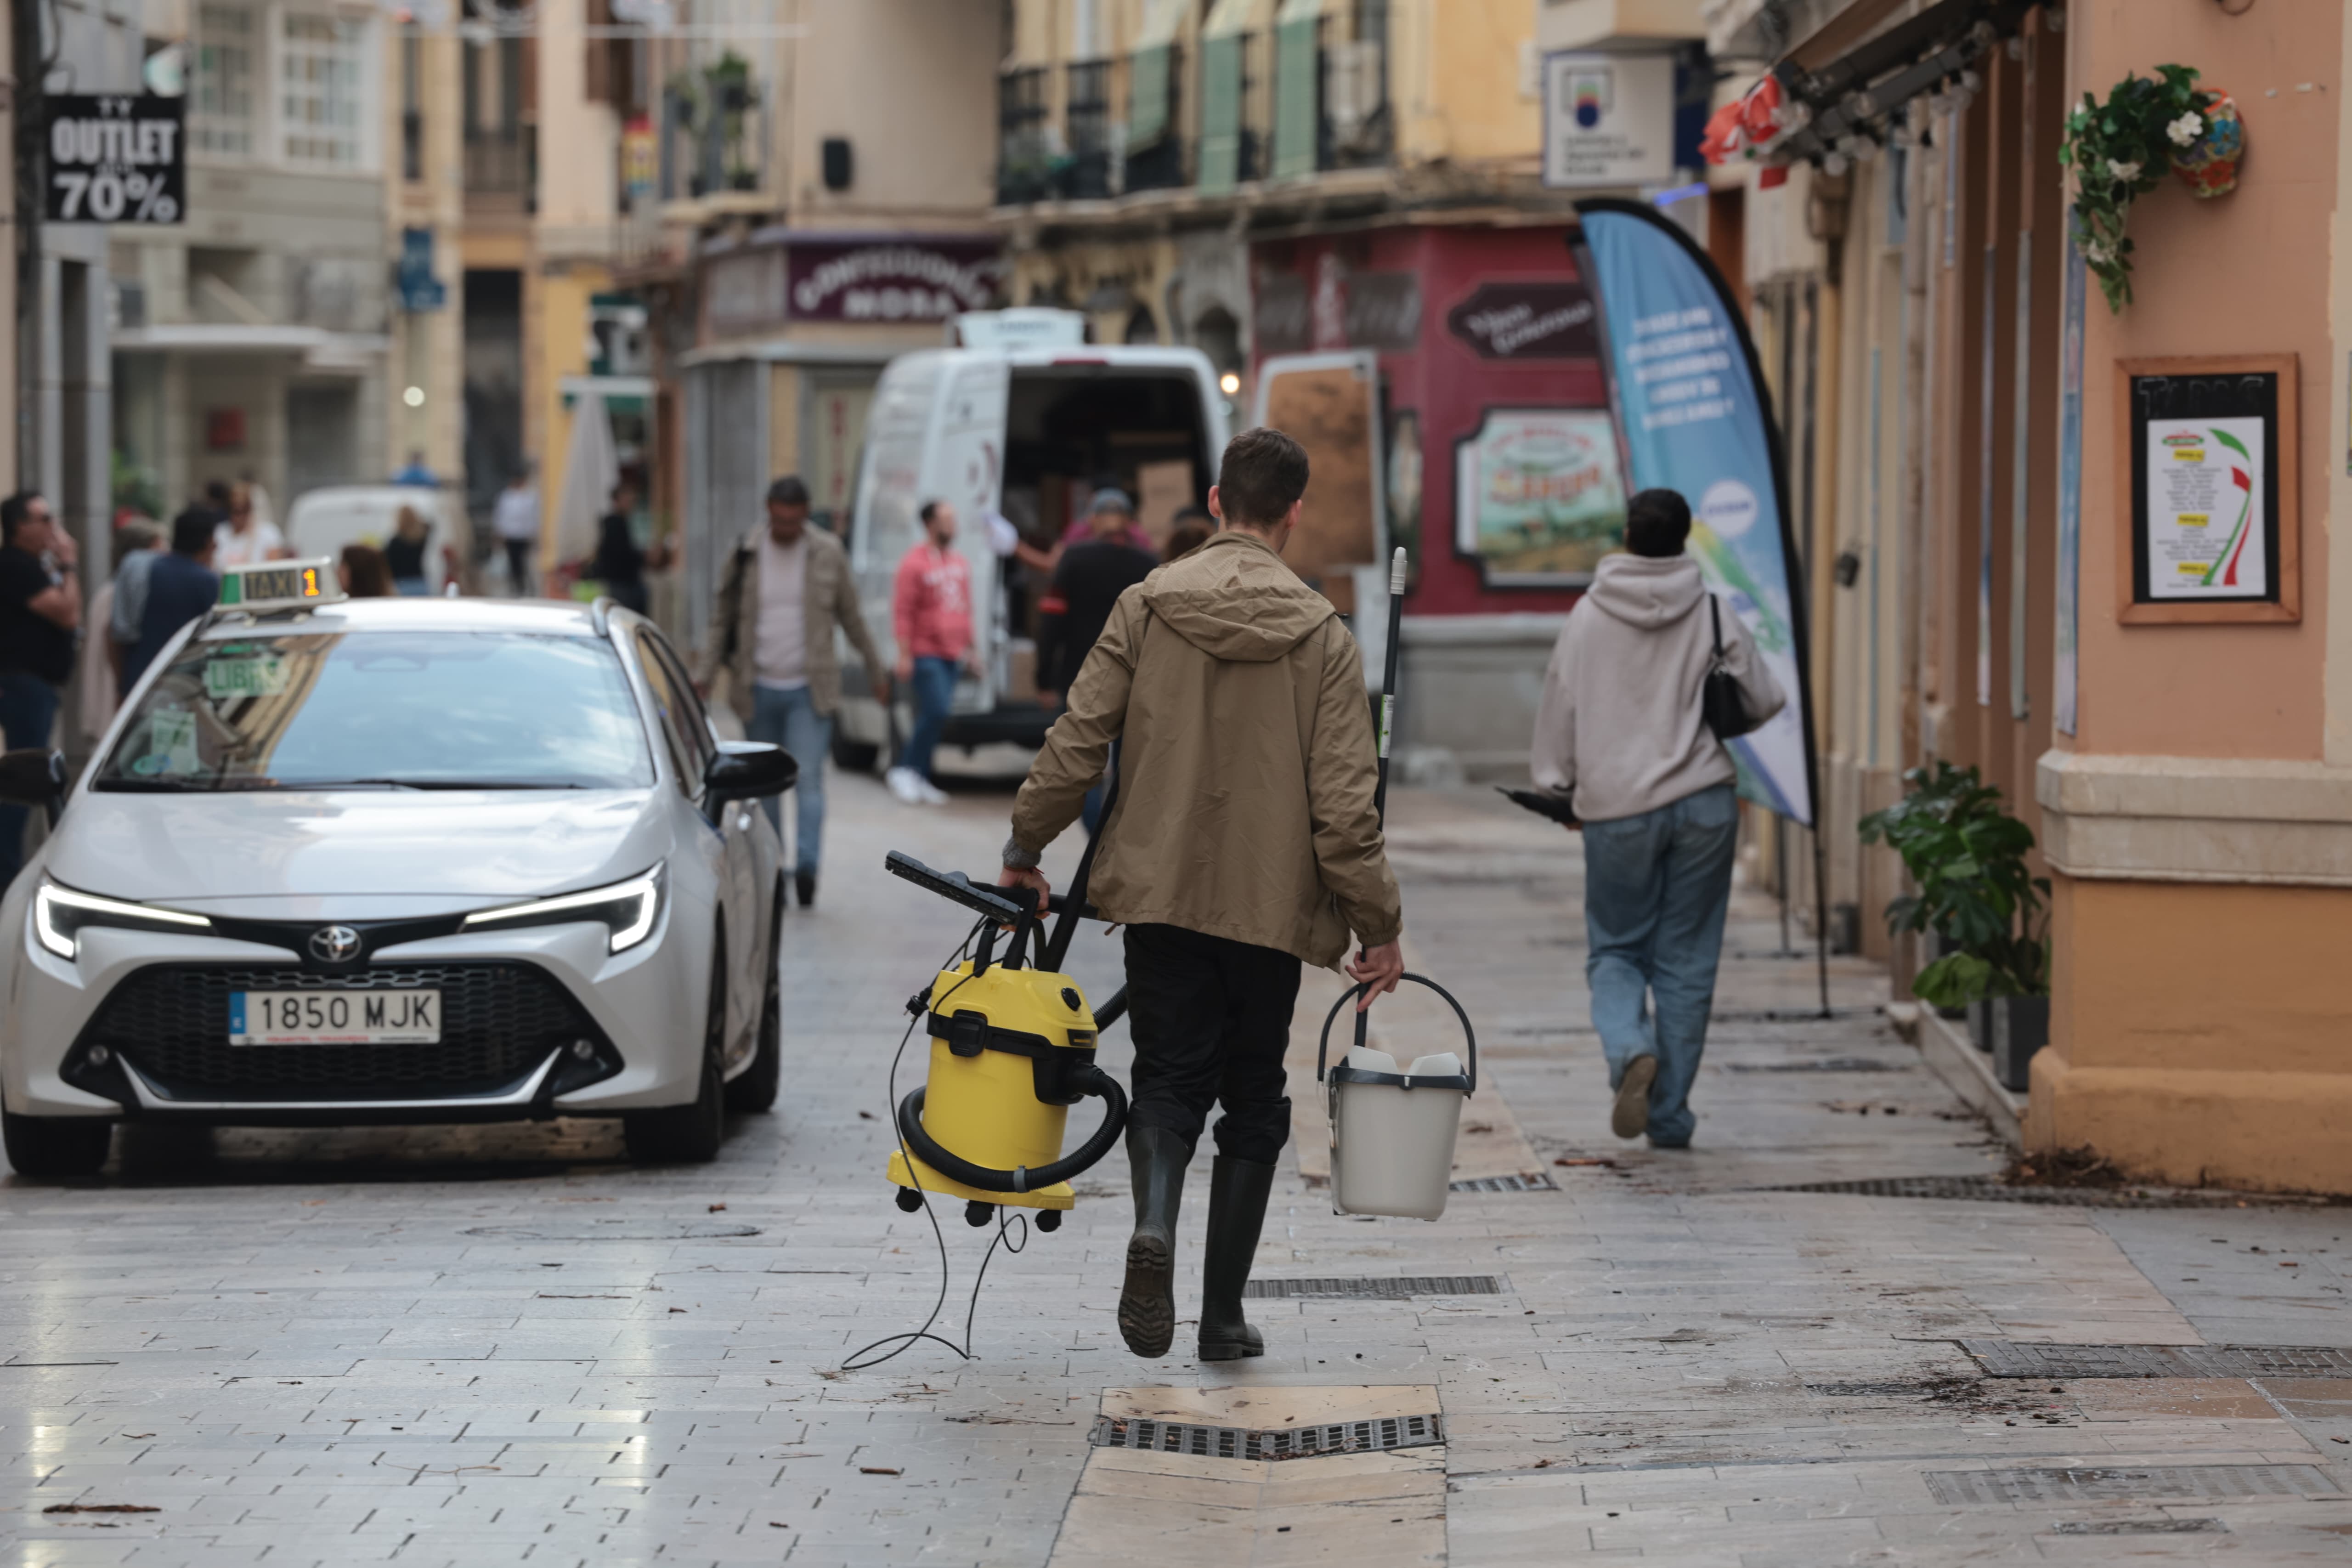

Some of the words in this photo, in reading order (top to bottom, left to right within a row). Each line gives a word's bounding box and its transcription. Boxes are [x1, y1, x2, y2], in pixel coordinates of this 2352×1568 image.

[51, 116, 178, 165] OUTLET
[53, 172, 178, 222] 70%
[246, 570, 296, 598] TAXI
[303, 568, 319, 596] 1
[262, 996, 349, 1030] 1850
[365, 995, 432, 1028] MJK
